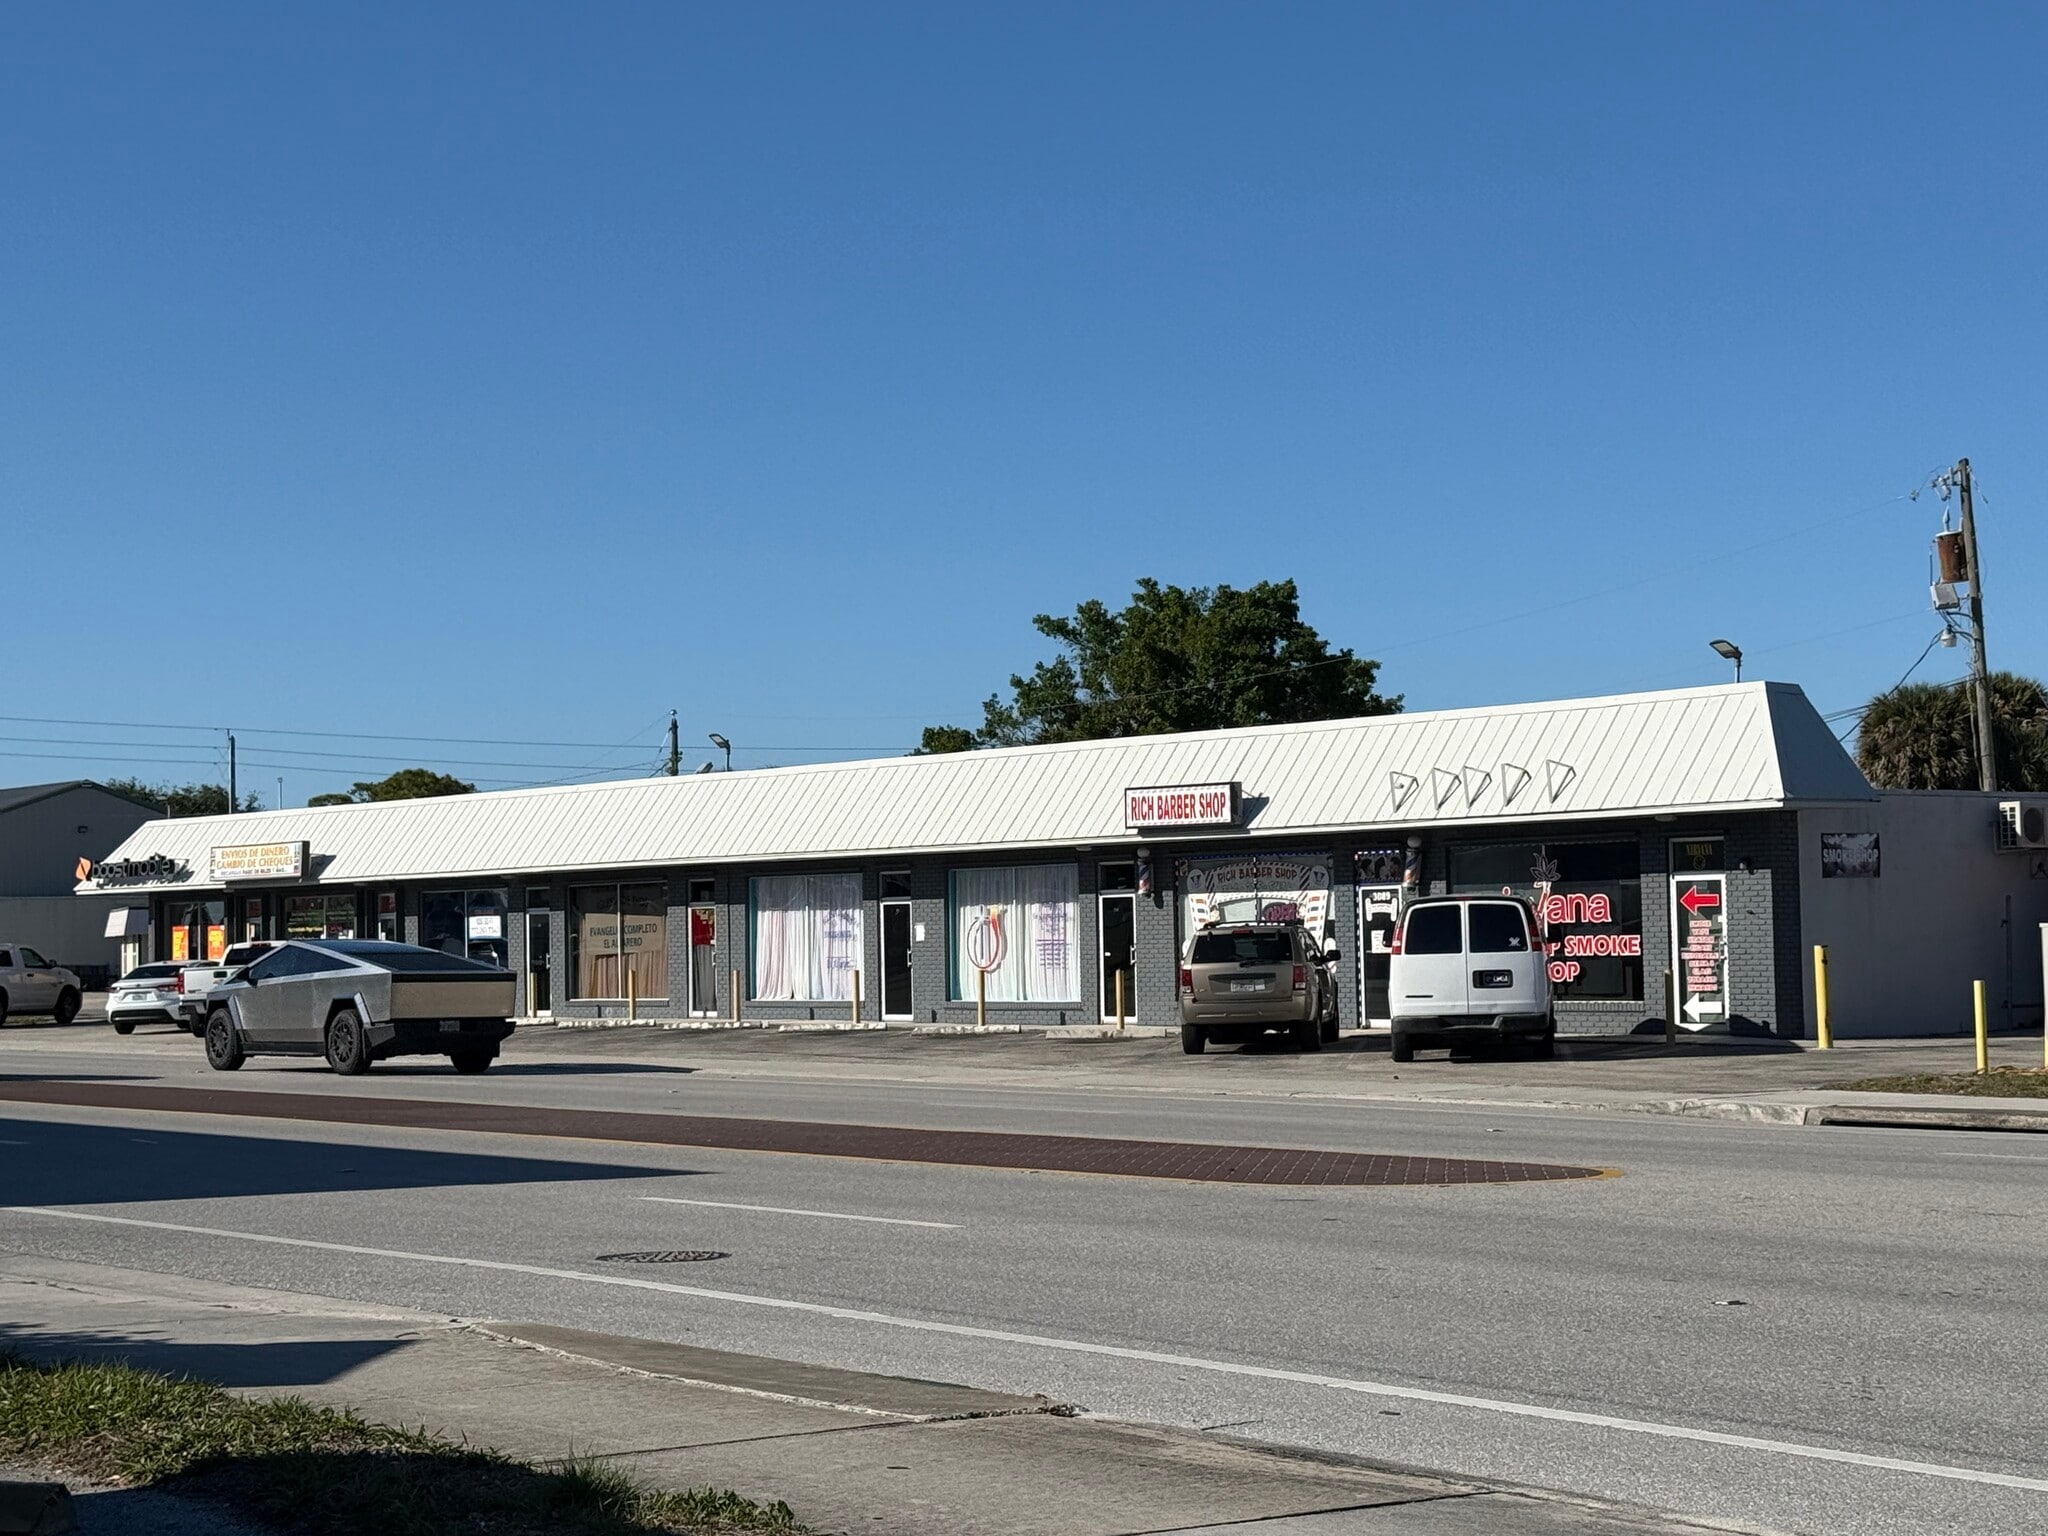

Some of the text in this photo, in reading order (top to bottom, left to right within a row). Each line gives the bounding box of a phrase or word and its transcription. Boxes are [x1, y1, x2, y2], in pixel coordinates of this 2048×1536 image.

[1131, 792, 1226, 821] RICH BARBER SHOP
[221, 846, 289, 859] ENVIOS DE DINERO
[216, 856, 293, 870] CAMBIO DE CHEQUES
[1217, 867, 1298, 882] RICH BARBER SHOP
[590, 923, 658, 937] EVANGELI COMPLETO
[603, 939, 611, 949] EL
[1564, 935, 1641, 957] SMOKE
[1548, 961, 1580, 982] OP
